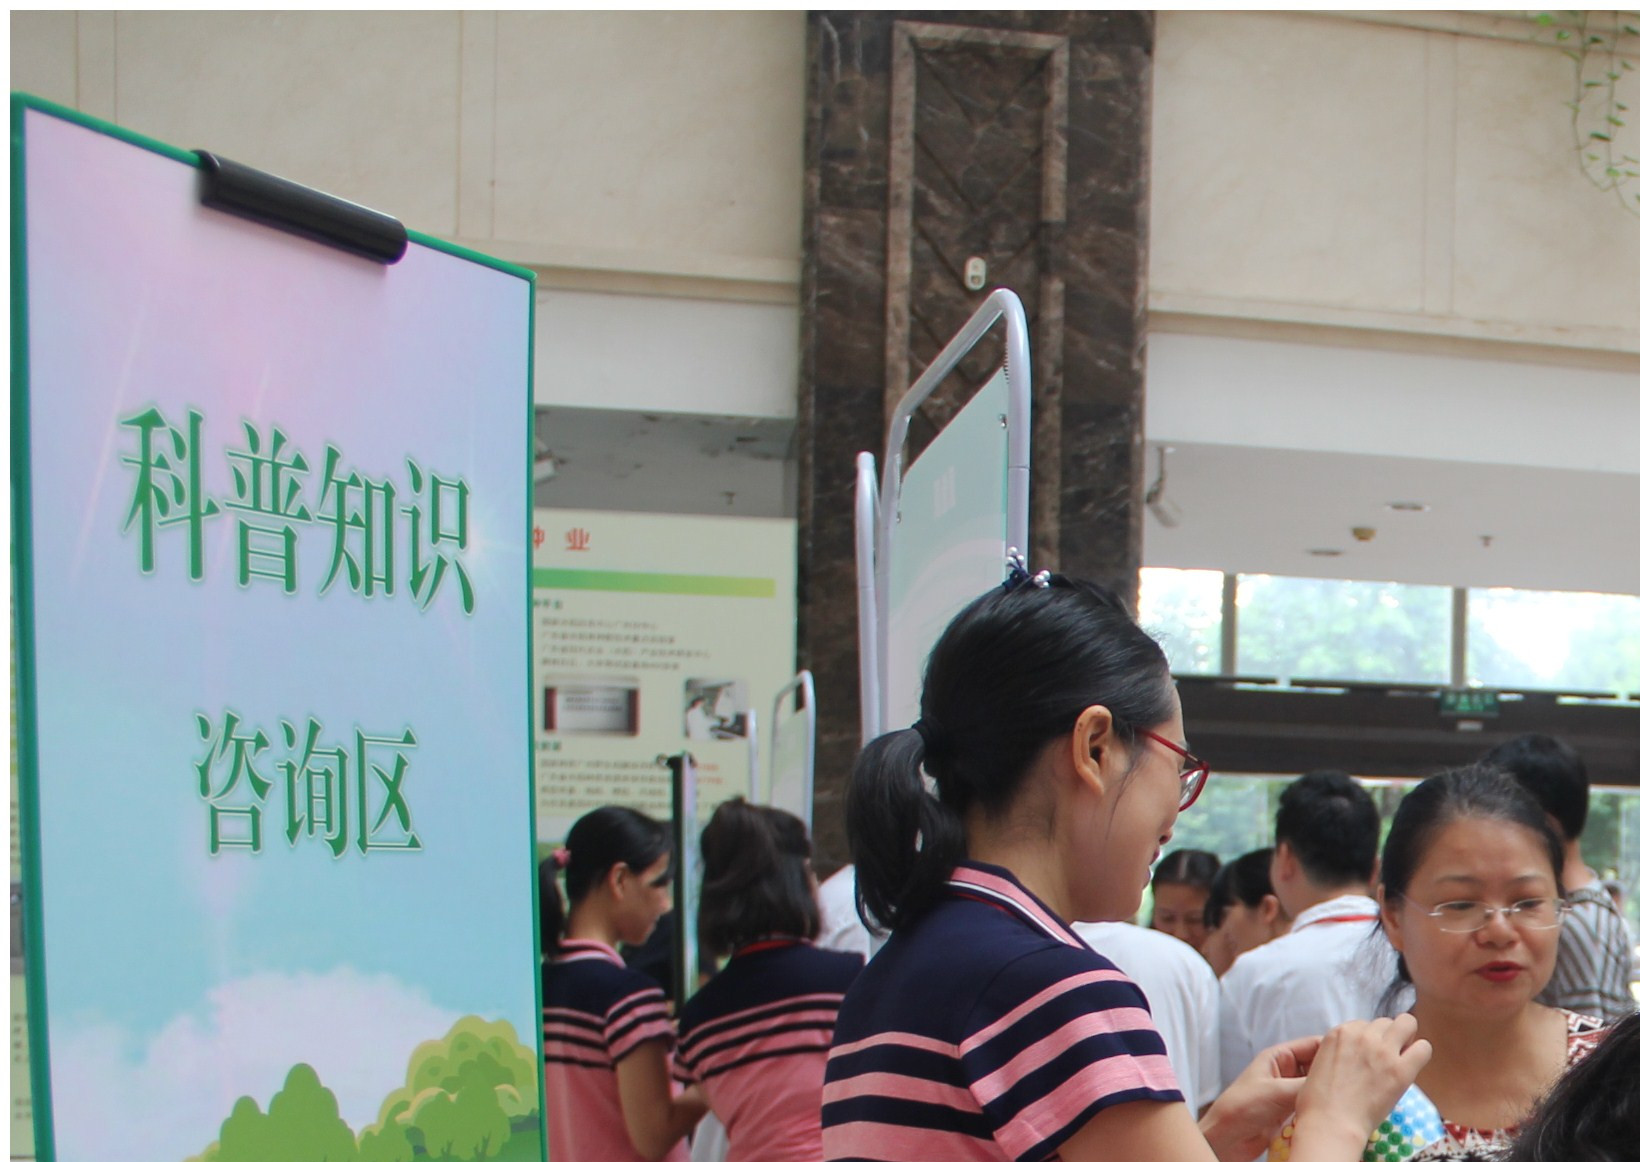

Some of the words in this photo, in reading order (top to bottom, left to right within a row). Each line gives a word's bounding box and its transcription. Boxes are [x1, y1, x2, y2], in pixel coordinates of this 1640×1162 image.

[119, 407, 478, 613] 科普知识
[195, 711, 422, 858] 咨询区
